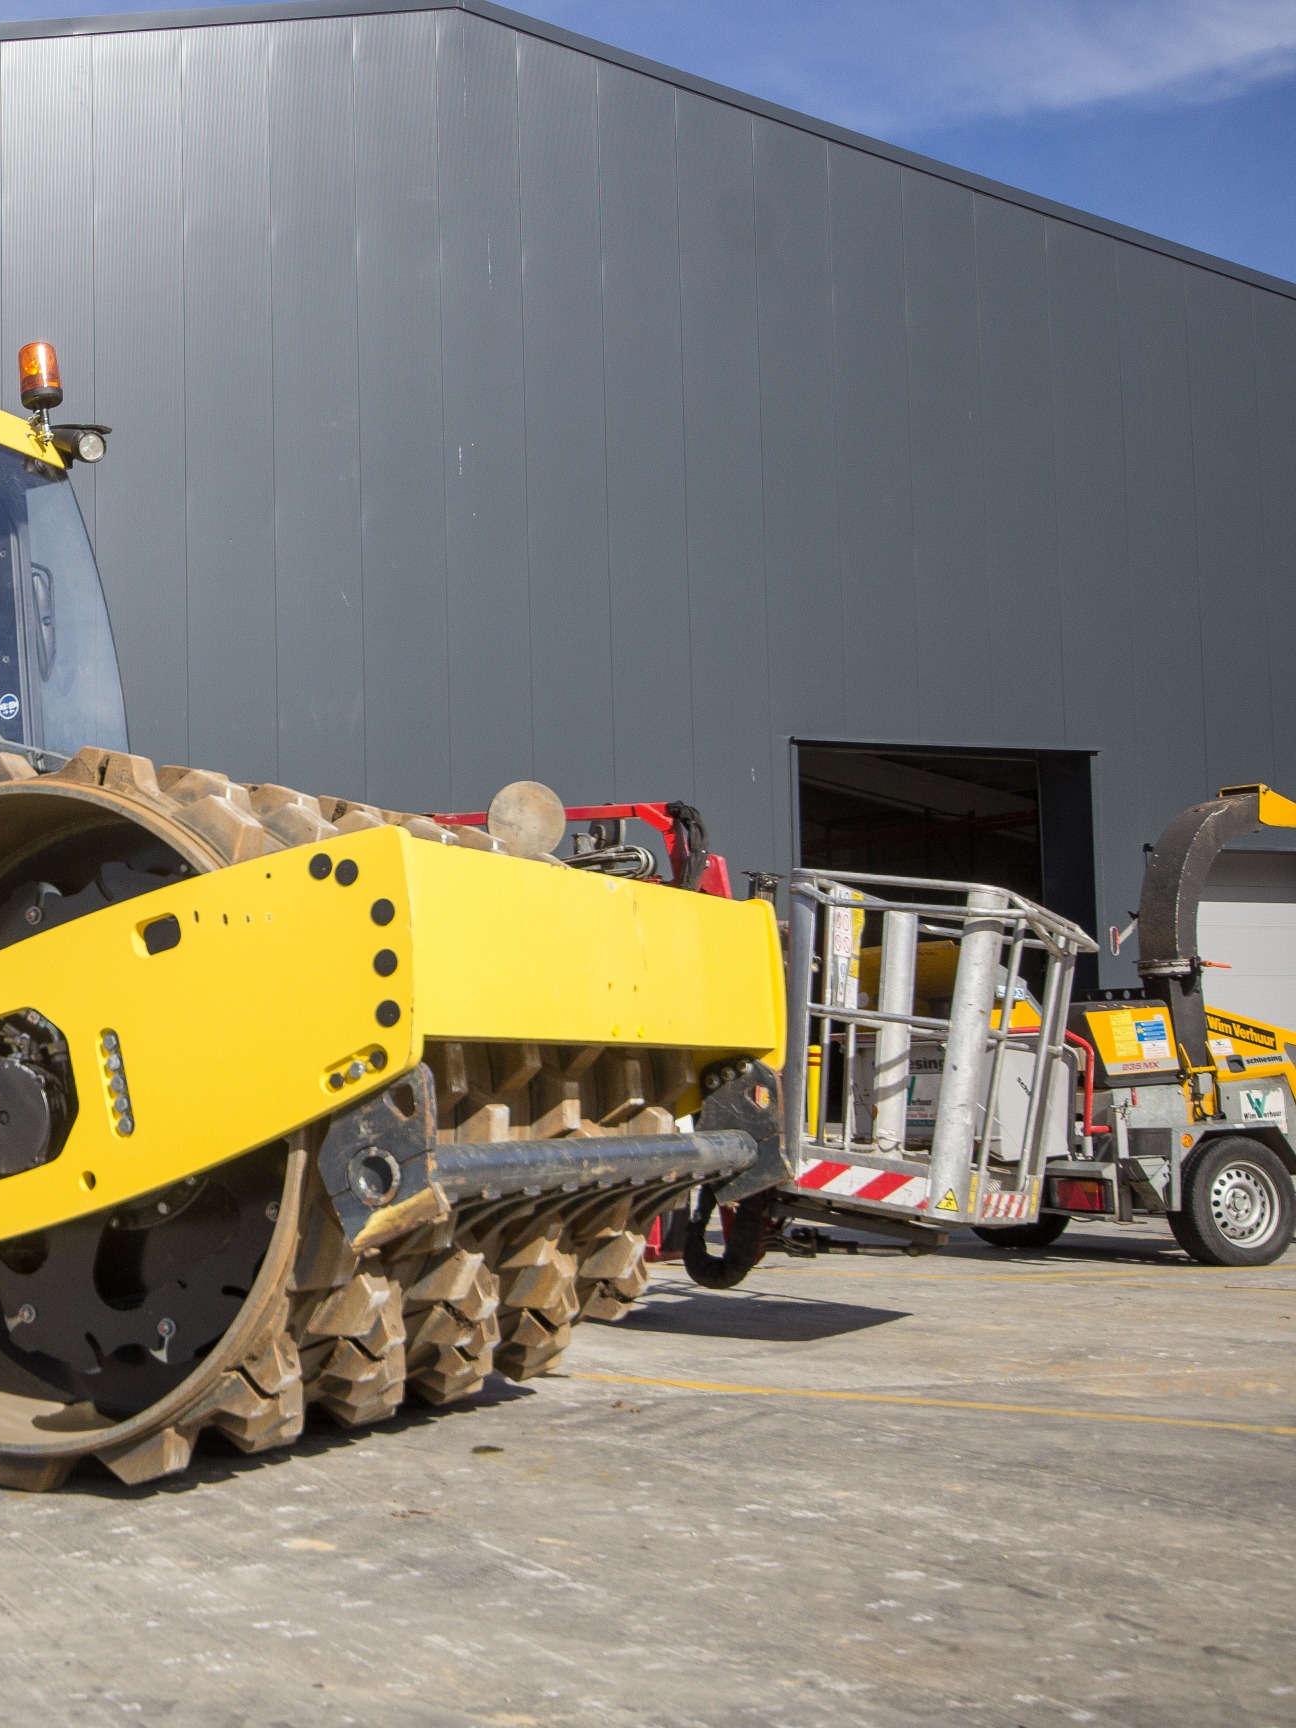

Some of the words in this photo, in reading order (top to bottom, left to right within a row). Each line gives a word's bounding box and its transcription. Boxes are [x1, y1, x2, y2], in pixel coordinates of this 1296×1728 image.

[1206, 1014, 1232, 1035] Wim
[1232, 1022, 1275, 1047] Verhuur
[1245, 1055, 1283, 1065] schliesing
